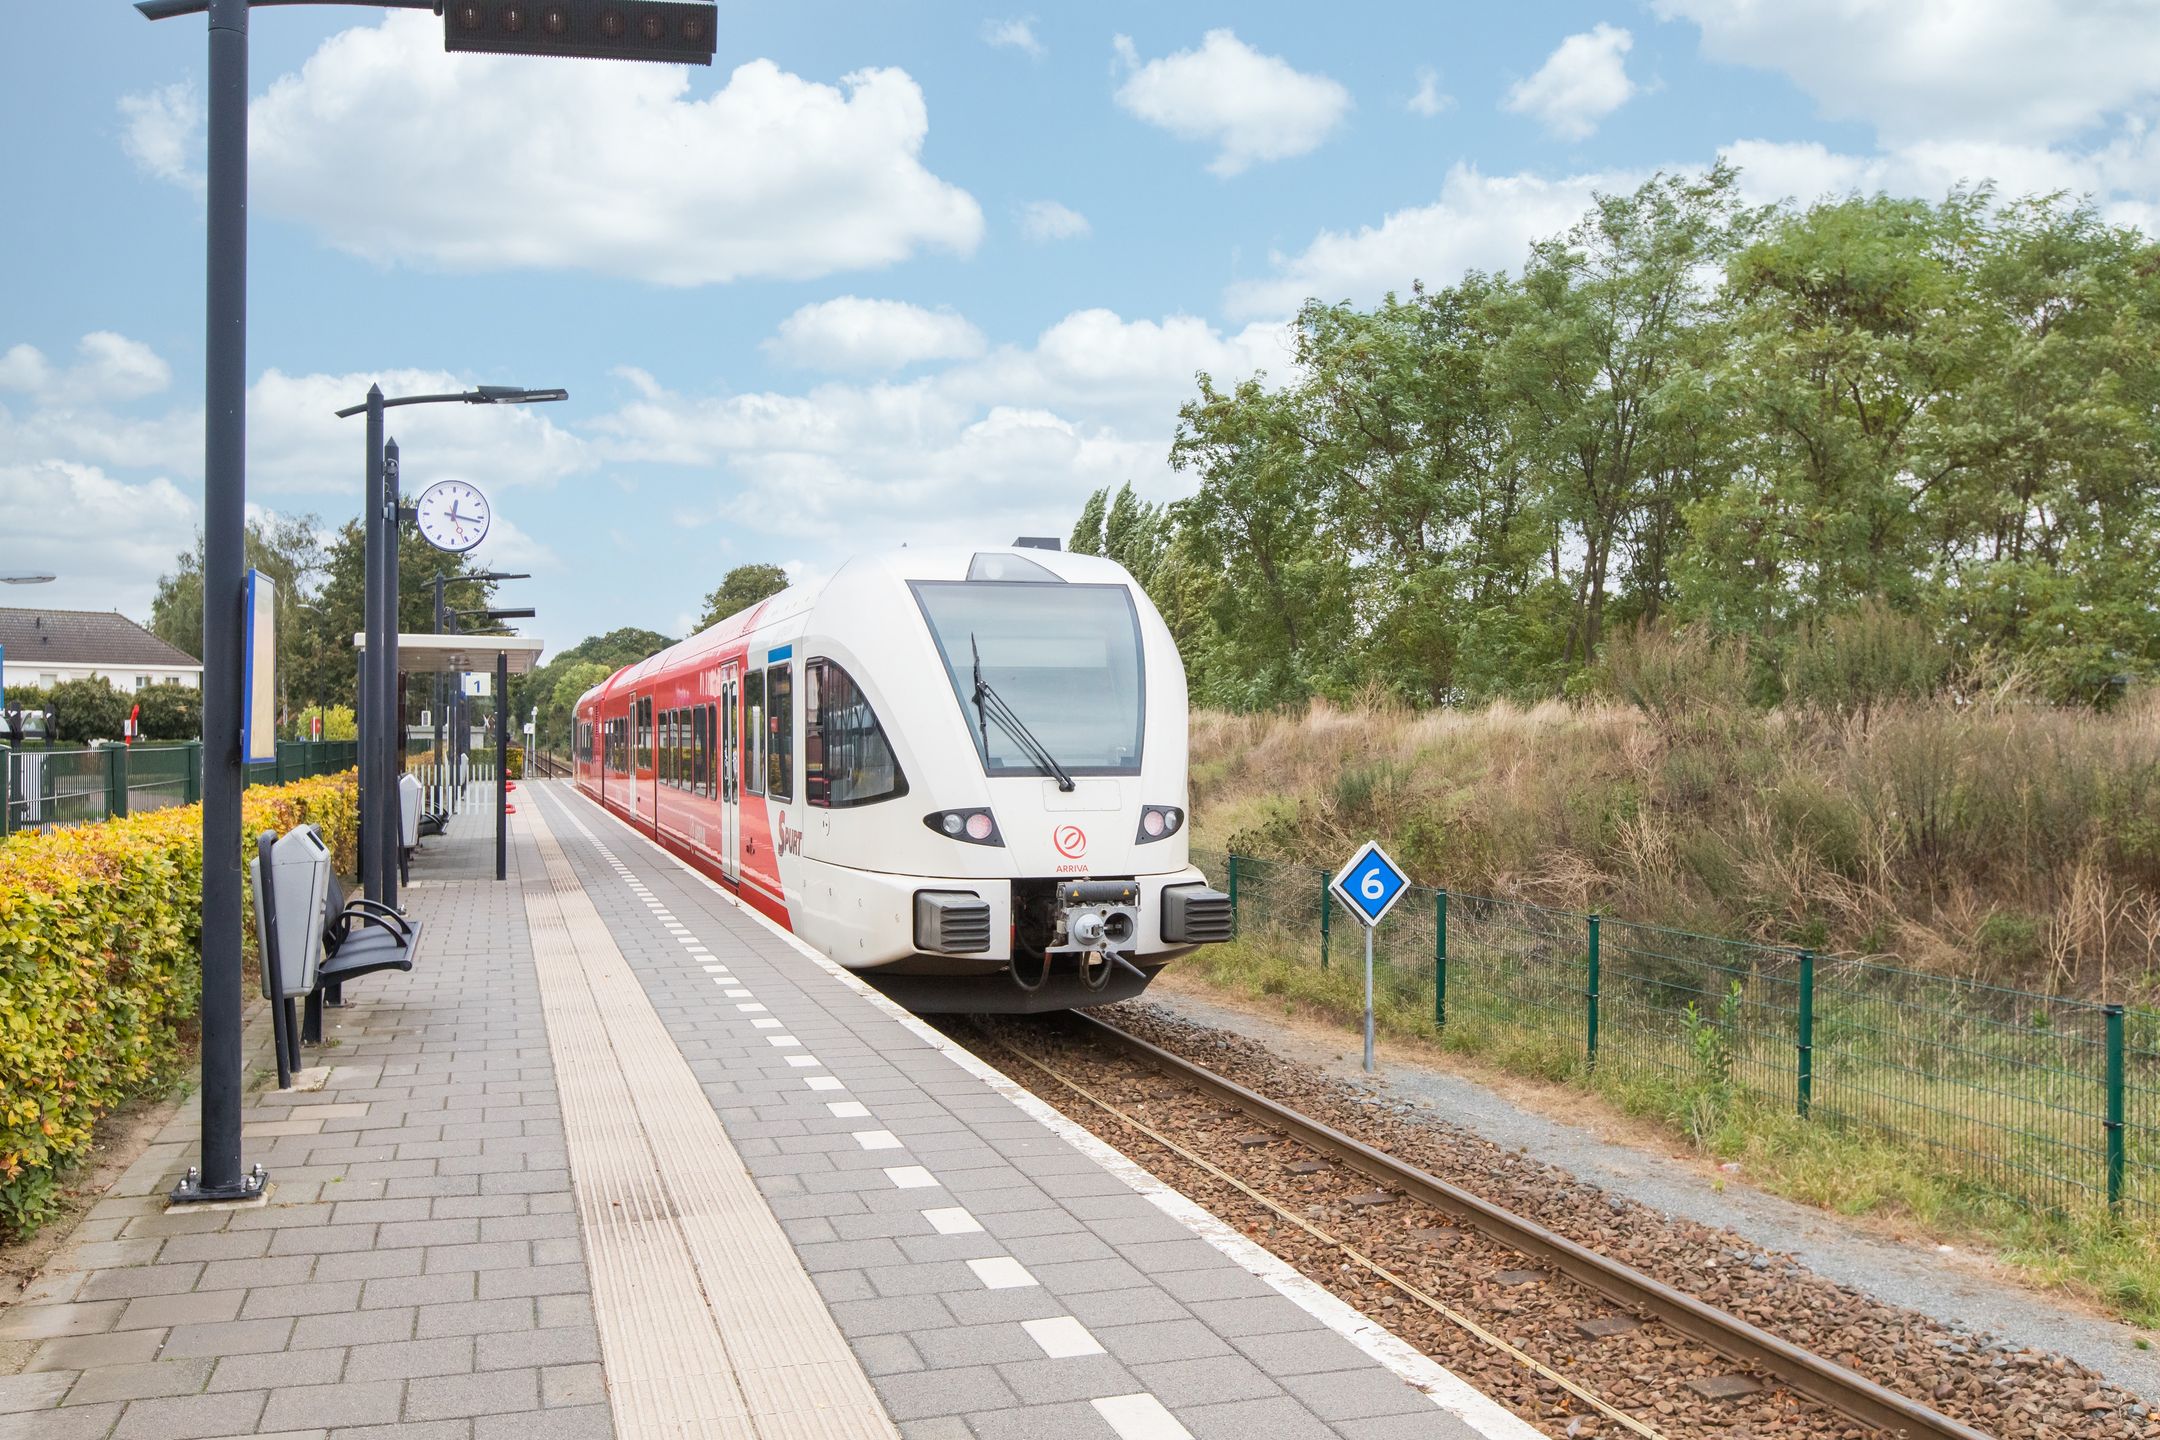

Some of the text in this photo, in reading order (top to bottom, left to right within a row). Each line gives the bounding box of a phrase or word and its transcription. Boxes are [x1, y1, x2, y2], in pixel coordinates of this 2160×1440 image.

[474, 680, 481, 694] 1
[1056, 864, 1088, 873] ARRIVA
[1361, 868, 1384, 900] 6
